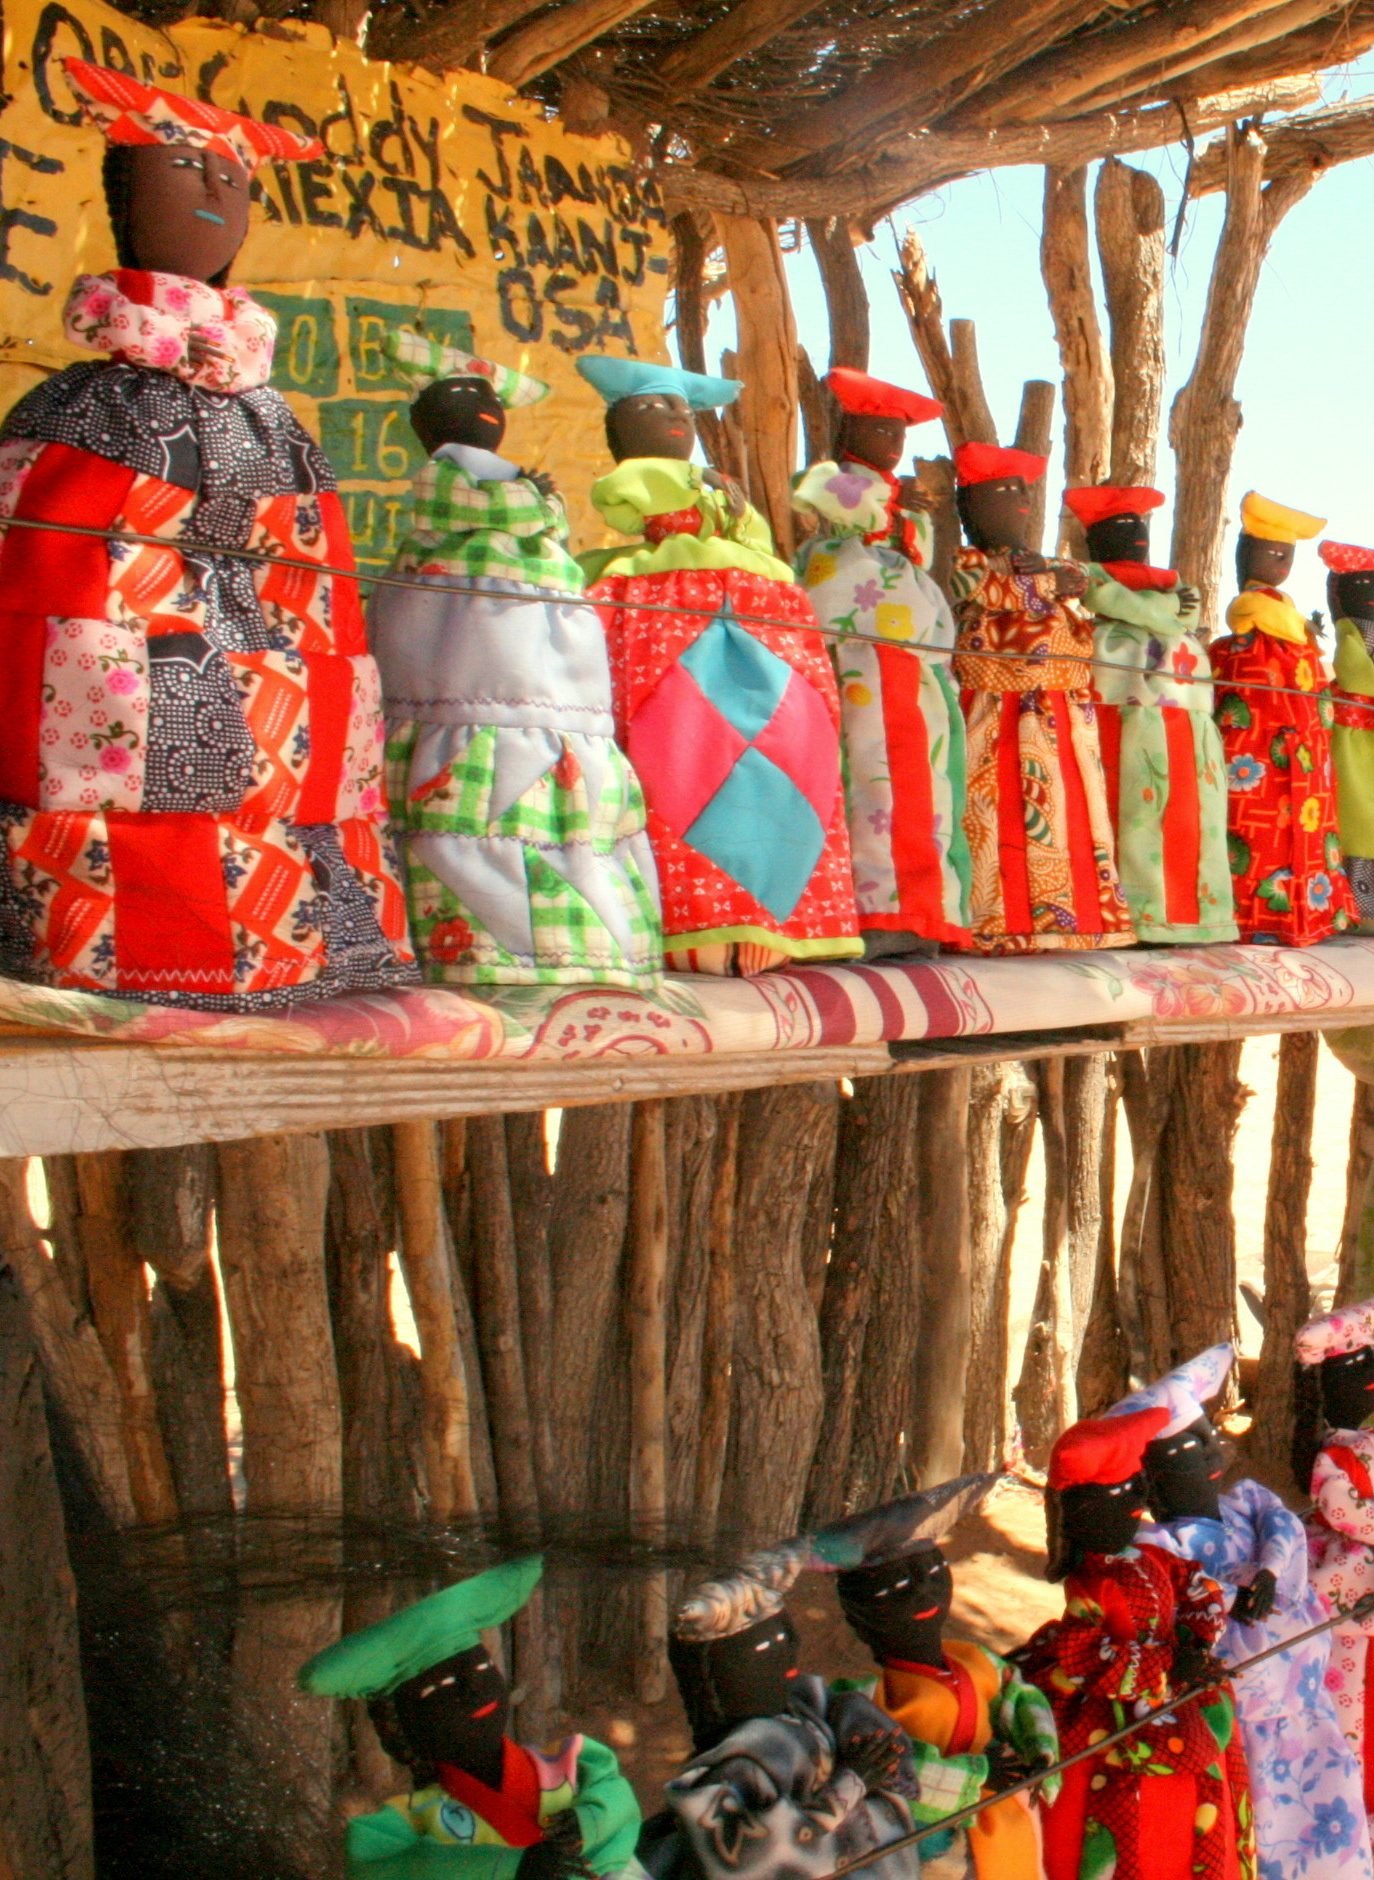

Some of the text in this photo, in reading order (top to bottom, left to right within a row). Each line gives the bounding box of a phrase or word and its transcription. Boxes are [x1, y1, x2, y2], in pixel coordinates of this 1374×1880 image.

[498, 267, 639, 357] OSA
[352, 410, 409, 478] 16
[350, 496, 417, 555] UI
